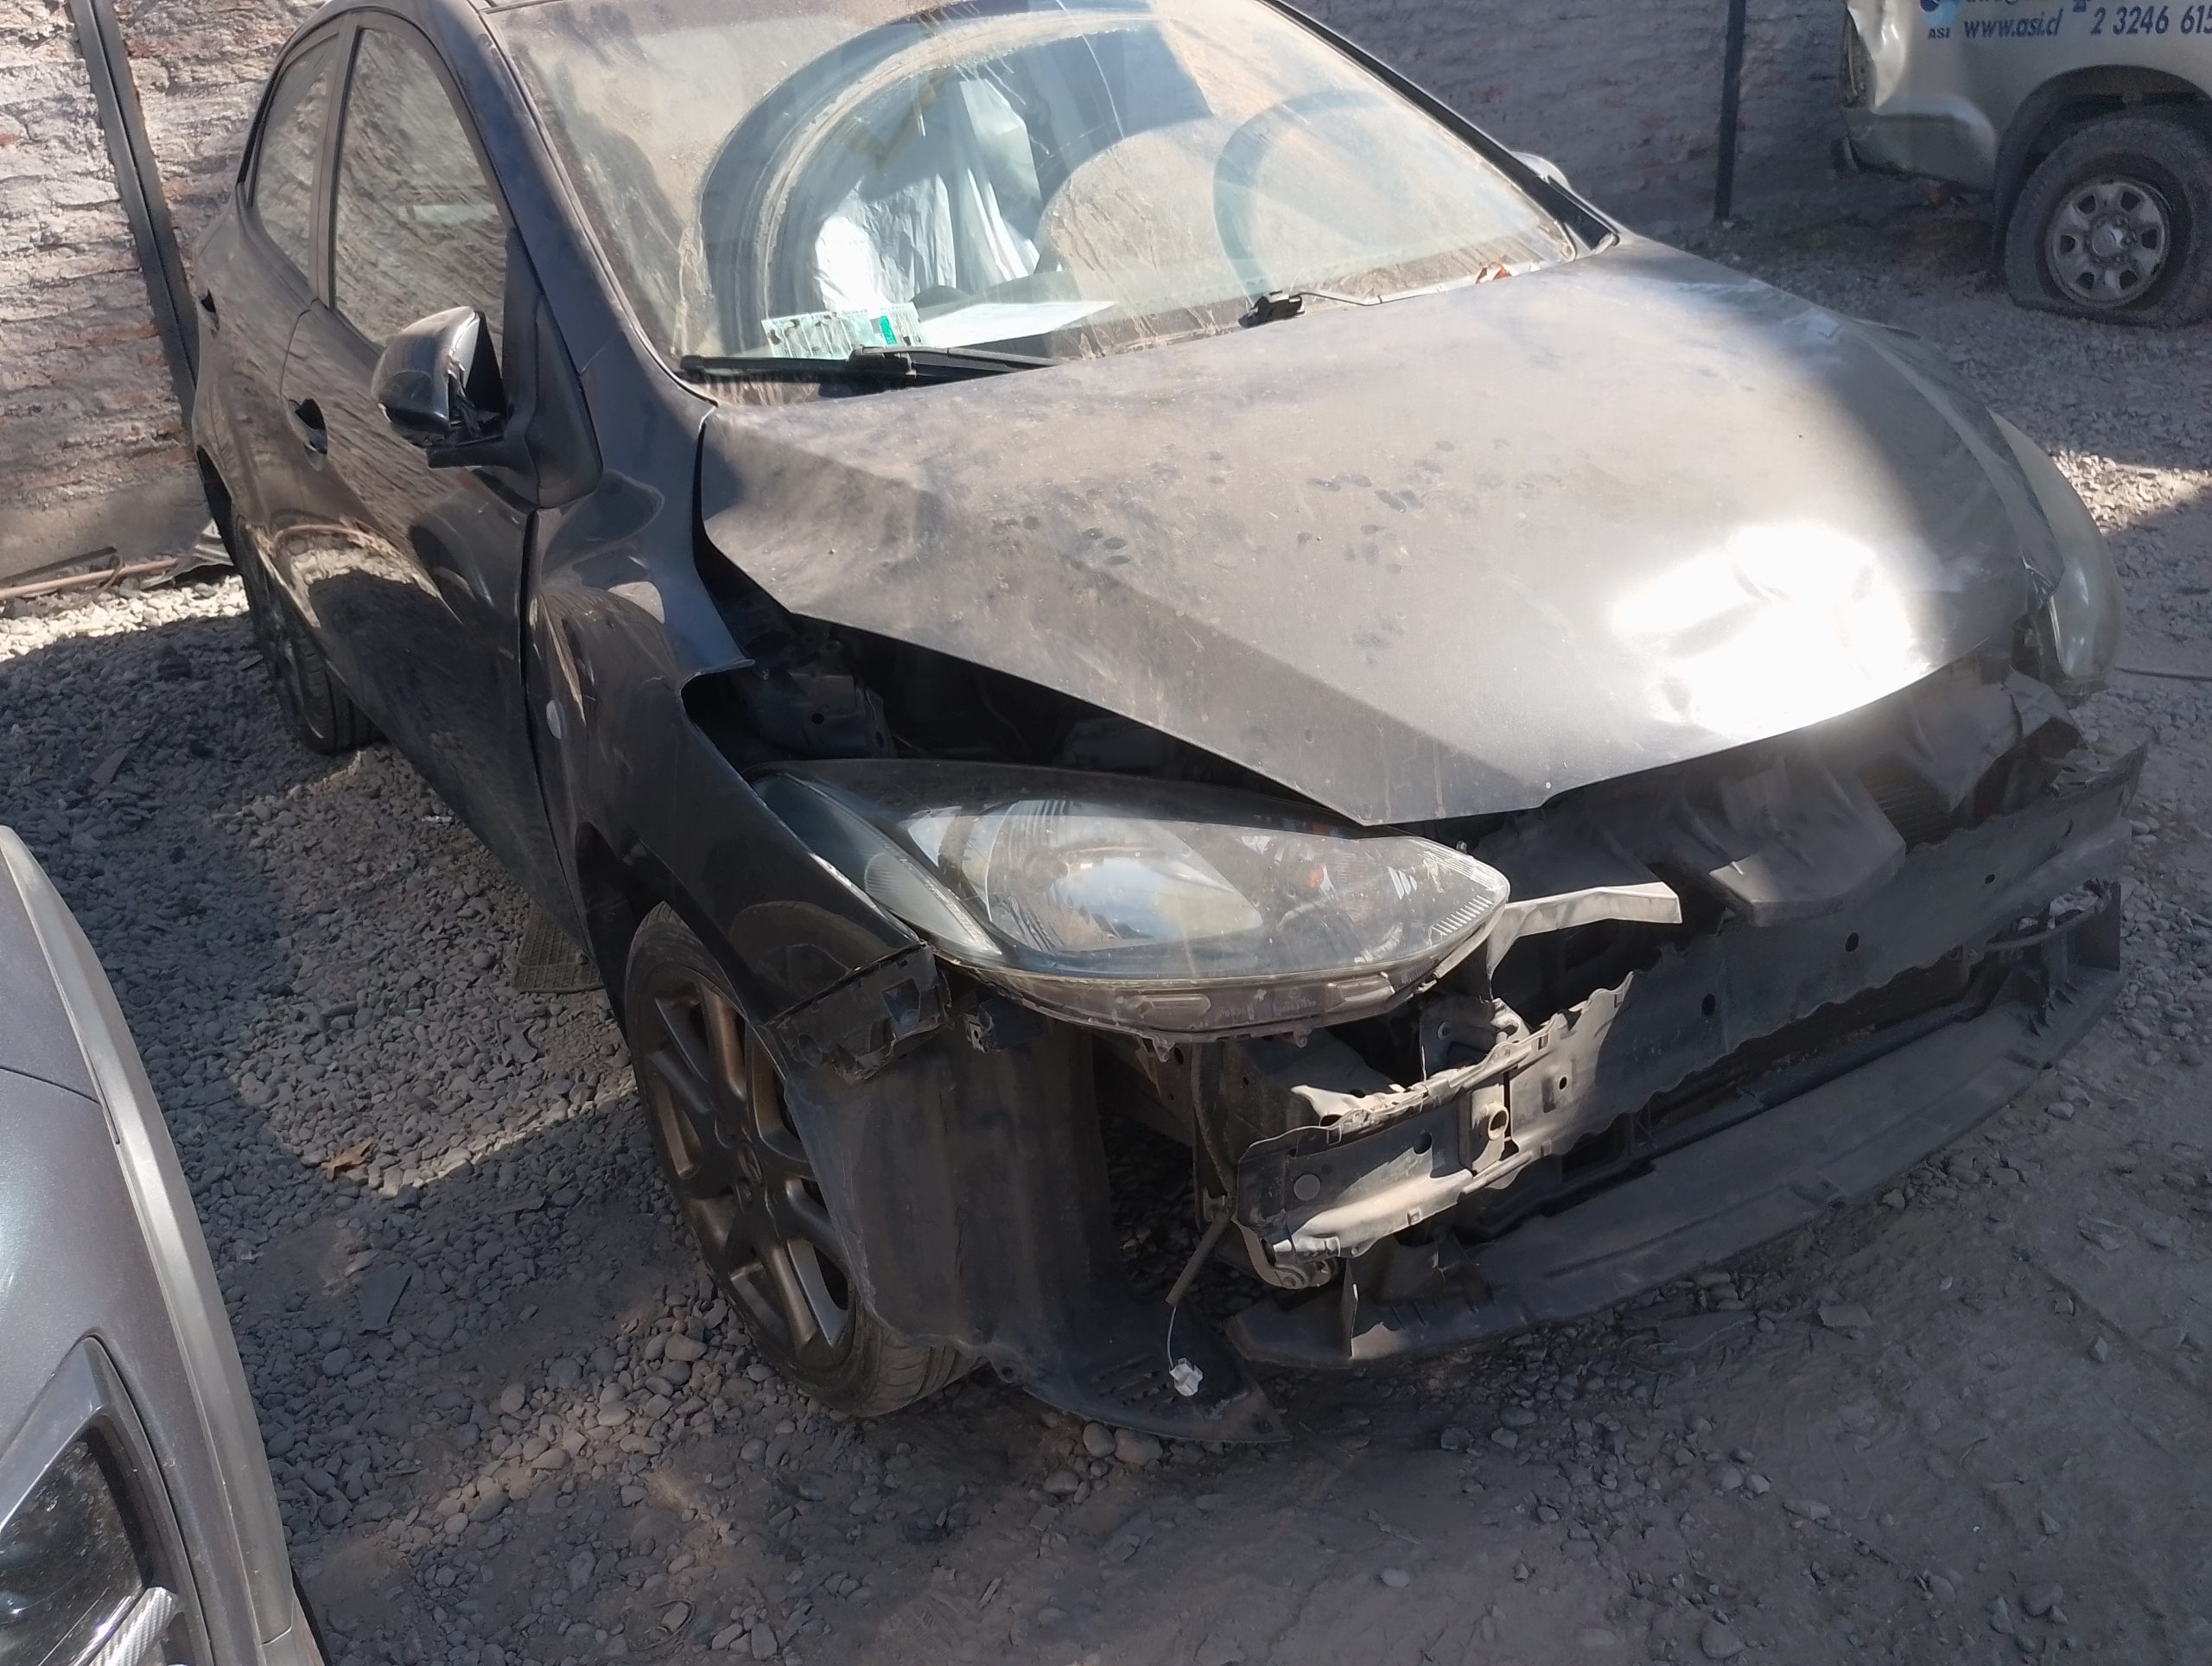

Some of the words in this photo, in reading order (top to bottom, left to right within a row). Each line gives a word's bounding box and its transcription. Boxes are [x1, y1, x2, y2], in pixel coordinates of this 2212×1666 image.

[2089, 6, 2107, 35] 2
[2113, 5, 2170, 35] 3246
[1928, 28, 1951, 40] ASI
